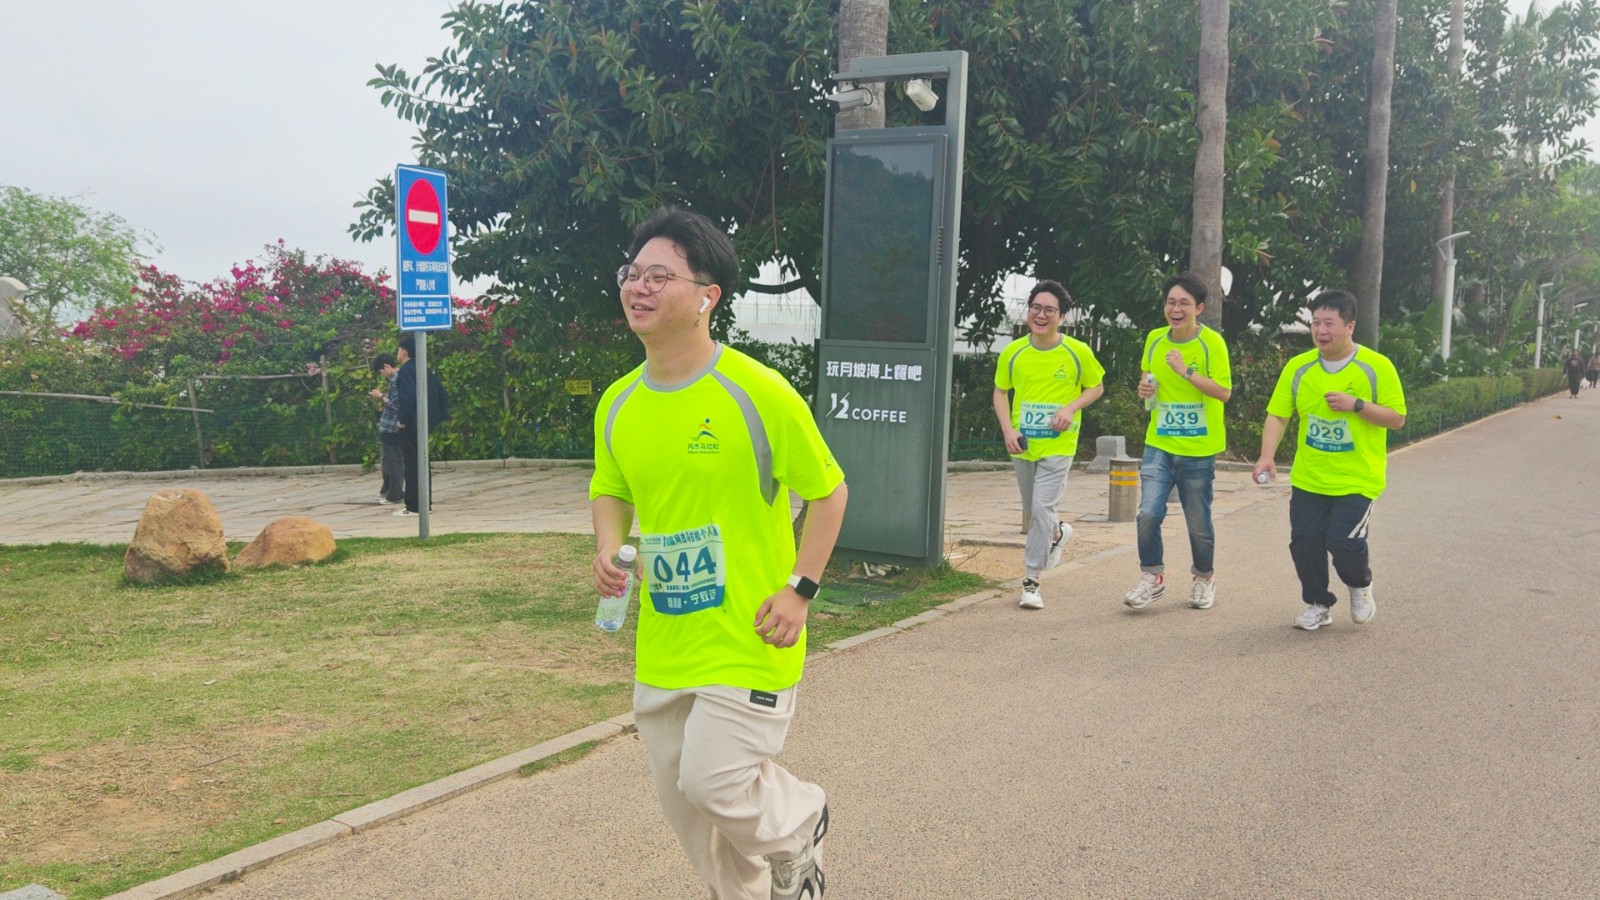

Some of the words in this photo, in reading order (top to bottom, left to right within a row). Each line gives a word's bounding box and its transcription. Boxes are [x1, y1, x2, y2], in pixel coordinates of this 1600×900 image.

[826, 361, 922, 381] 玩月坡海上餐吧
[852, 408, 907, 423] COFFEE
[1165, 411, 1199, 425] 039
[1310, 423, 1344, 440] 029
[653, 546, 717, 583] 044
